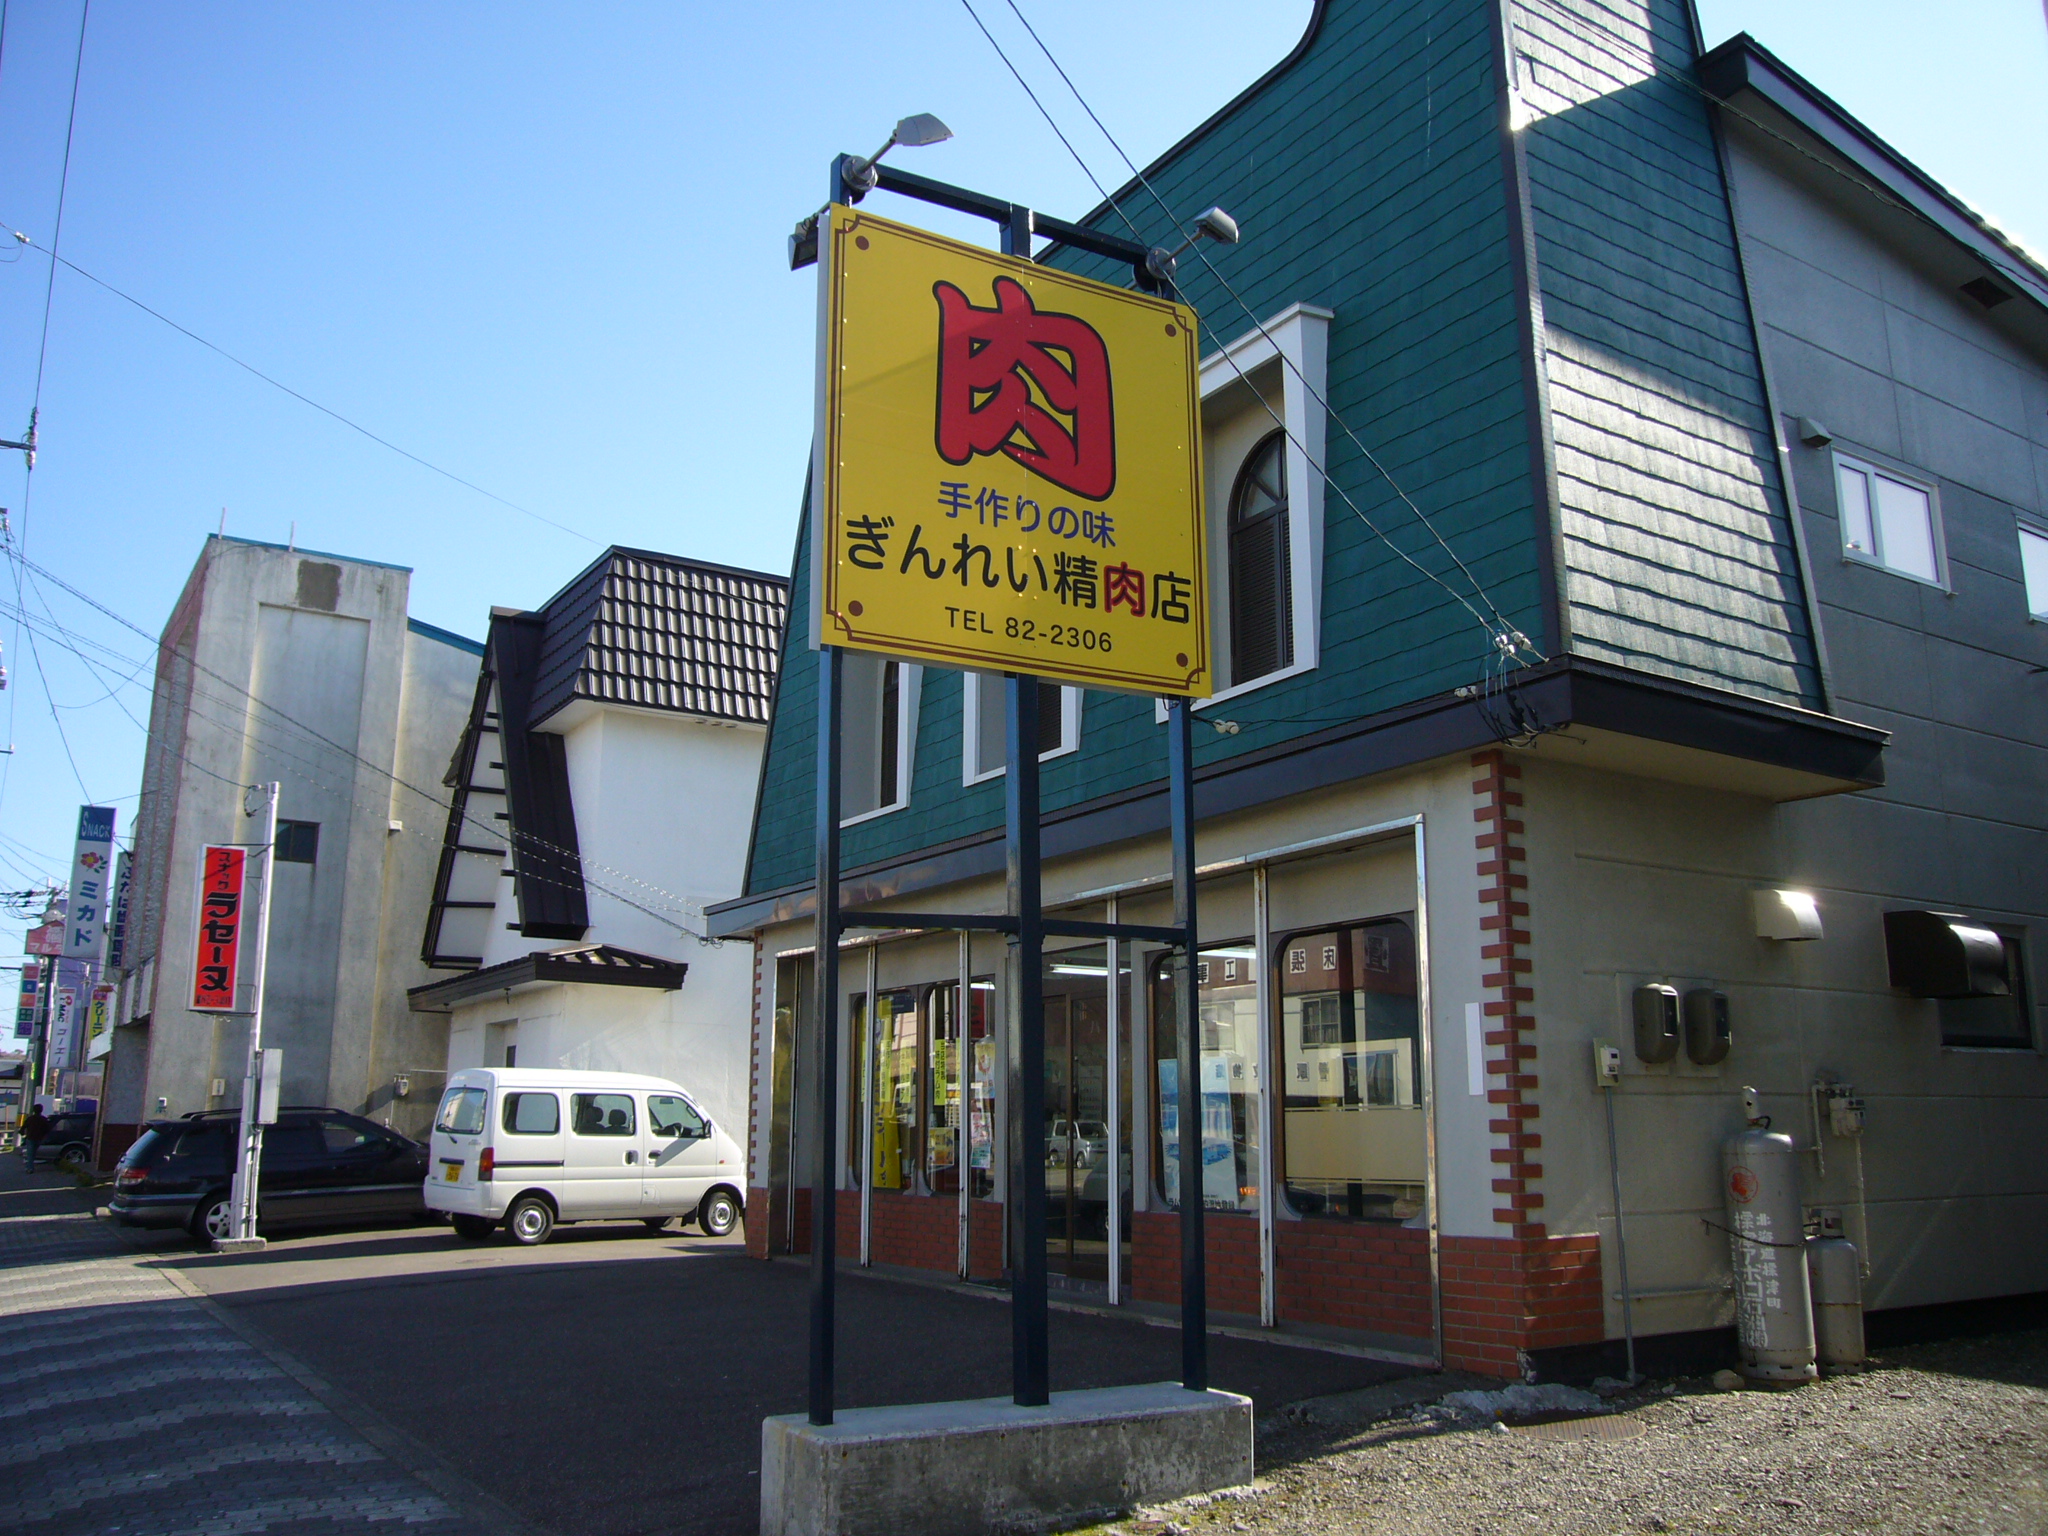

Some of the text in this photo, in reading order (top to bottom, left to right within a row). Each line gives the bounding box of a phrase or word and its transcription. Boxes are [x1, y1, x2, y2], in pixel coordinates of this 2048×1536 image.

[932, 275, 1116, 502] 肉
[937, 480, 1116, 549] 手作りの味
[846, 514, 1192, 624] ぎんれい精肉店
[944, 606, 1113, 653] TEL 82-2306
[217, 851, 231, 890] スナック
[74, 879, 99, 947] ミカド
[201, 891, 239, 992] ラセーヌ
[1756, 1213, 1782, 1310] 北海道標津町
